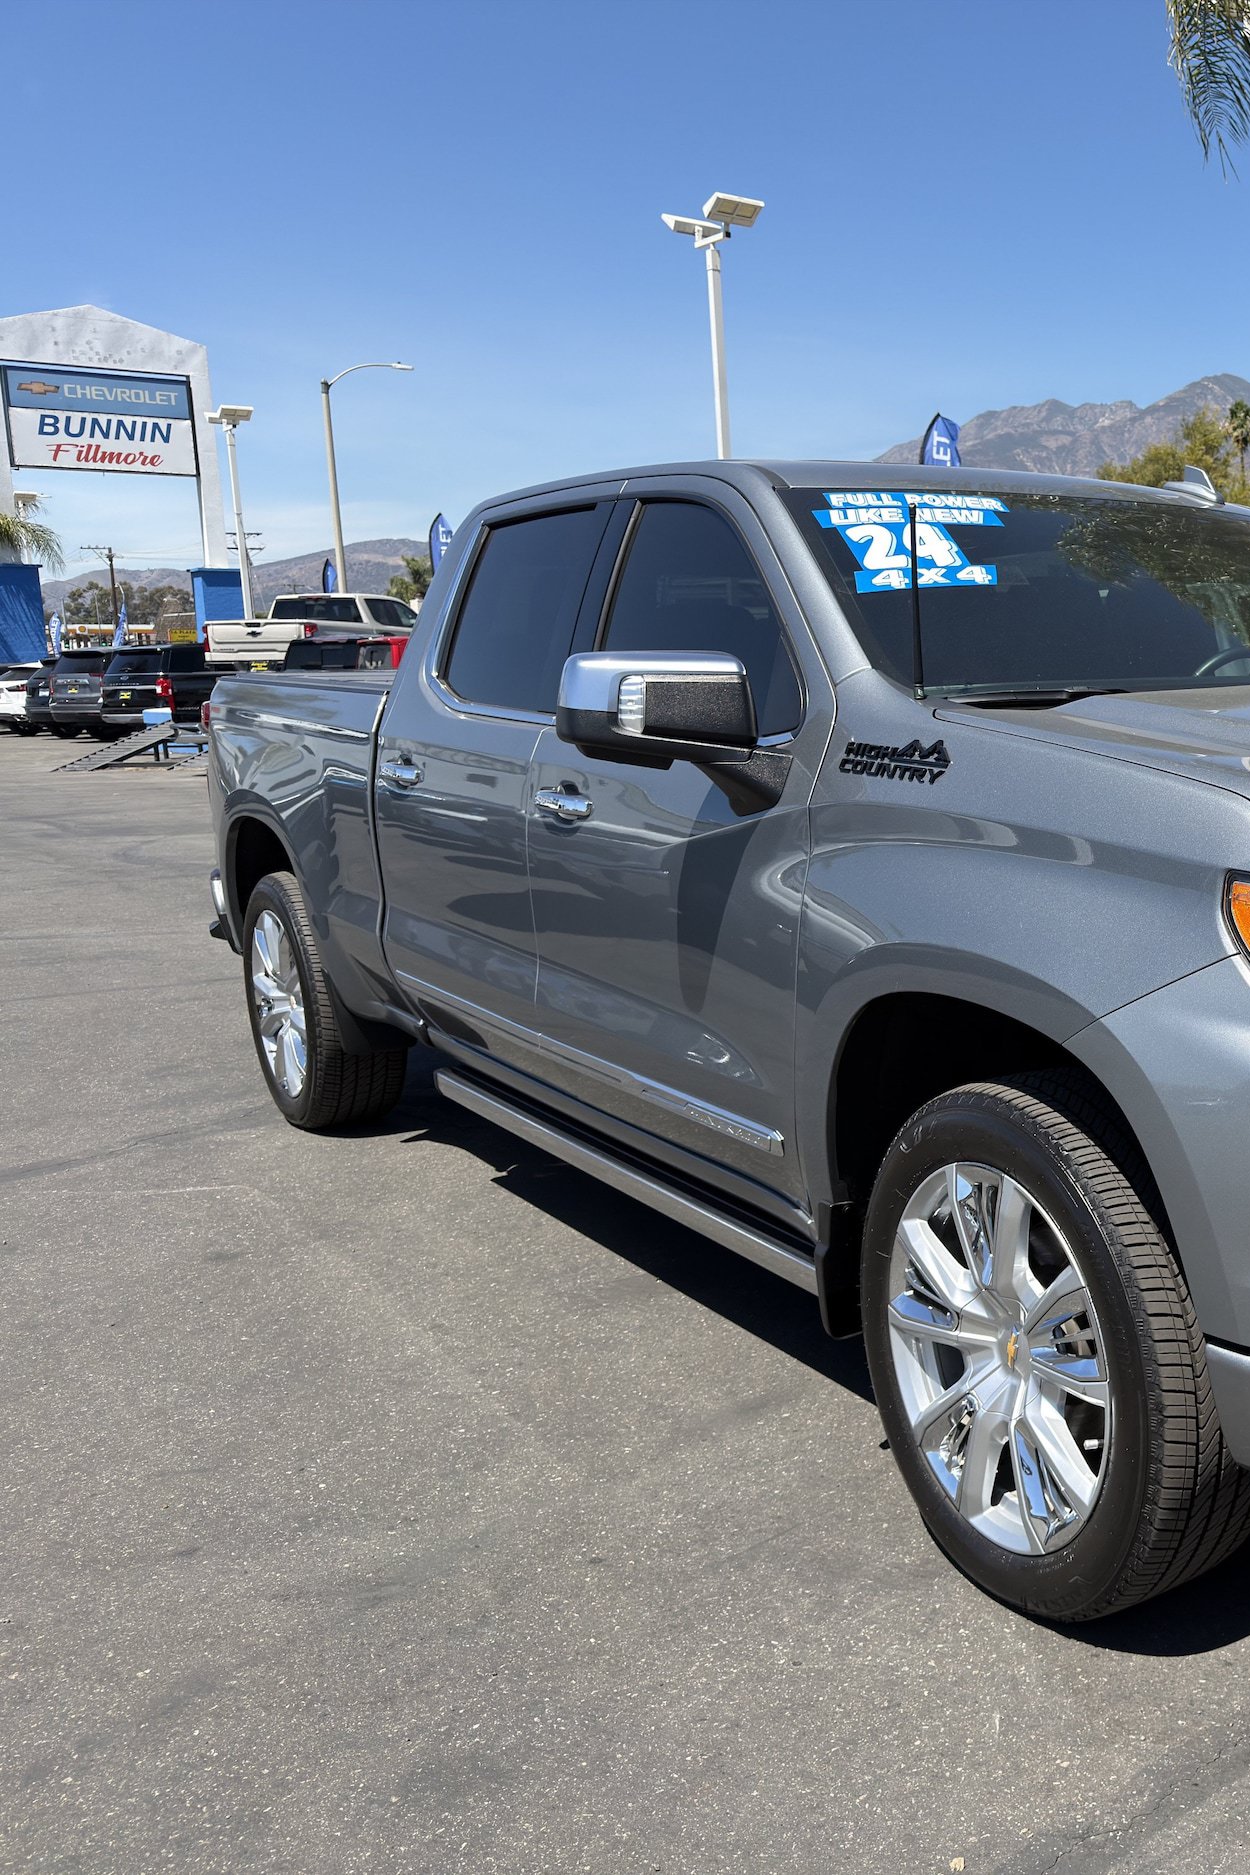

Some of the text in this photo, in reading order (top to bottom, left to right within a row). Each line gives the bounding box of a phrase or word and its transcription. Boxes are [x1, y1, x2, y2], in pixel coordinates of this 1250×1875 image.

[64, 384, 178, 405] CHEVROLET
[38, 414, 172, 443] BUNNIN
[46, 443, 164, 466] Fillmore
[828, 493, 1002, 511] FULL POWER
[828, 508, 984, 524] LIKE NEW
[845, 523, 962, 570] 24
[845, 742, 900, 760] HIGH
[839, 758, 946, 785] COUNTRY
